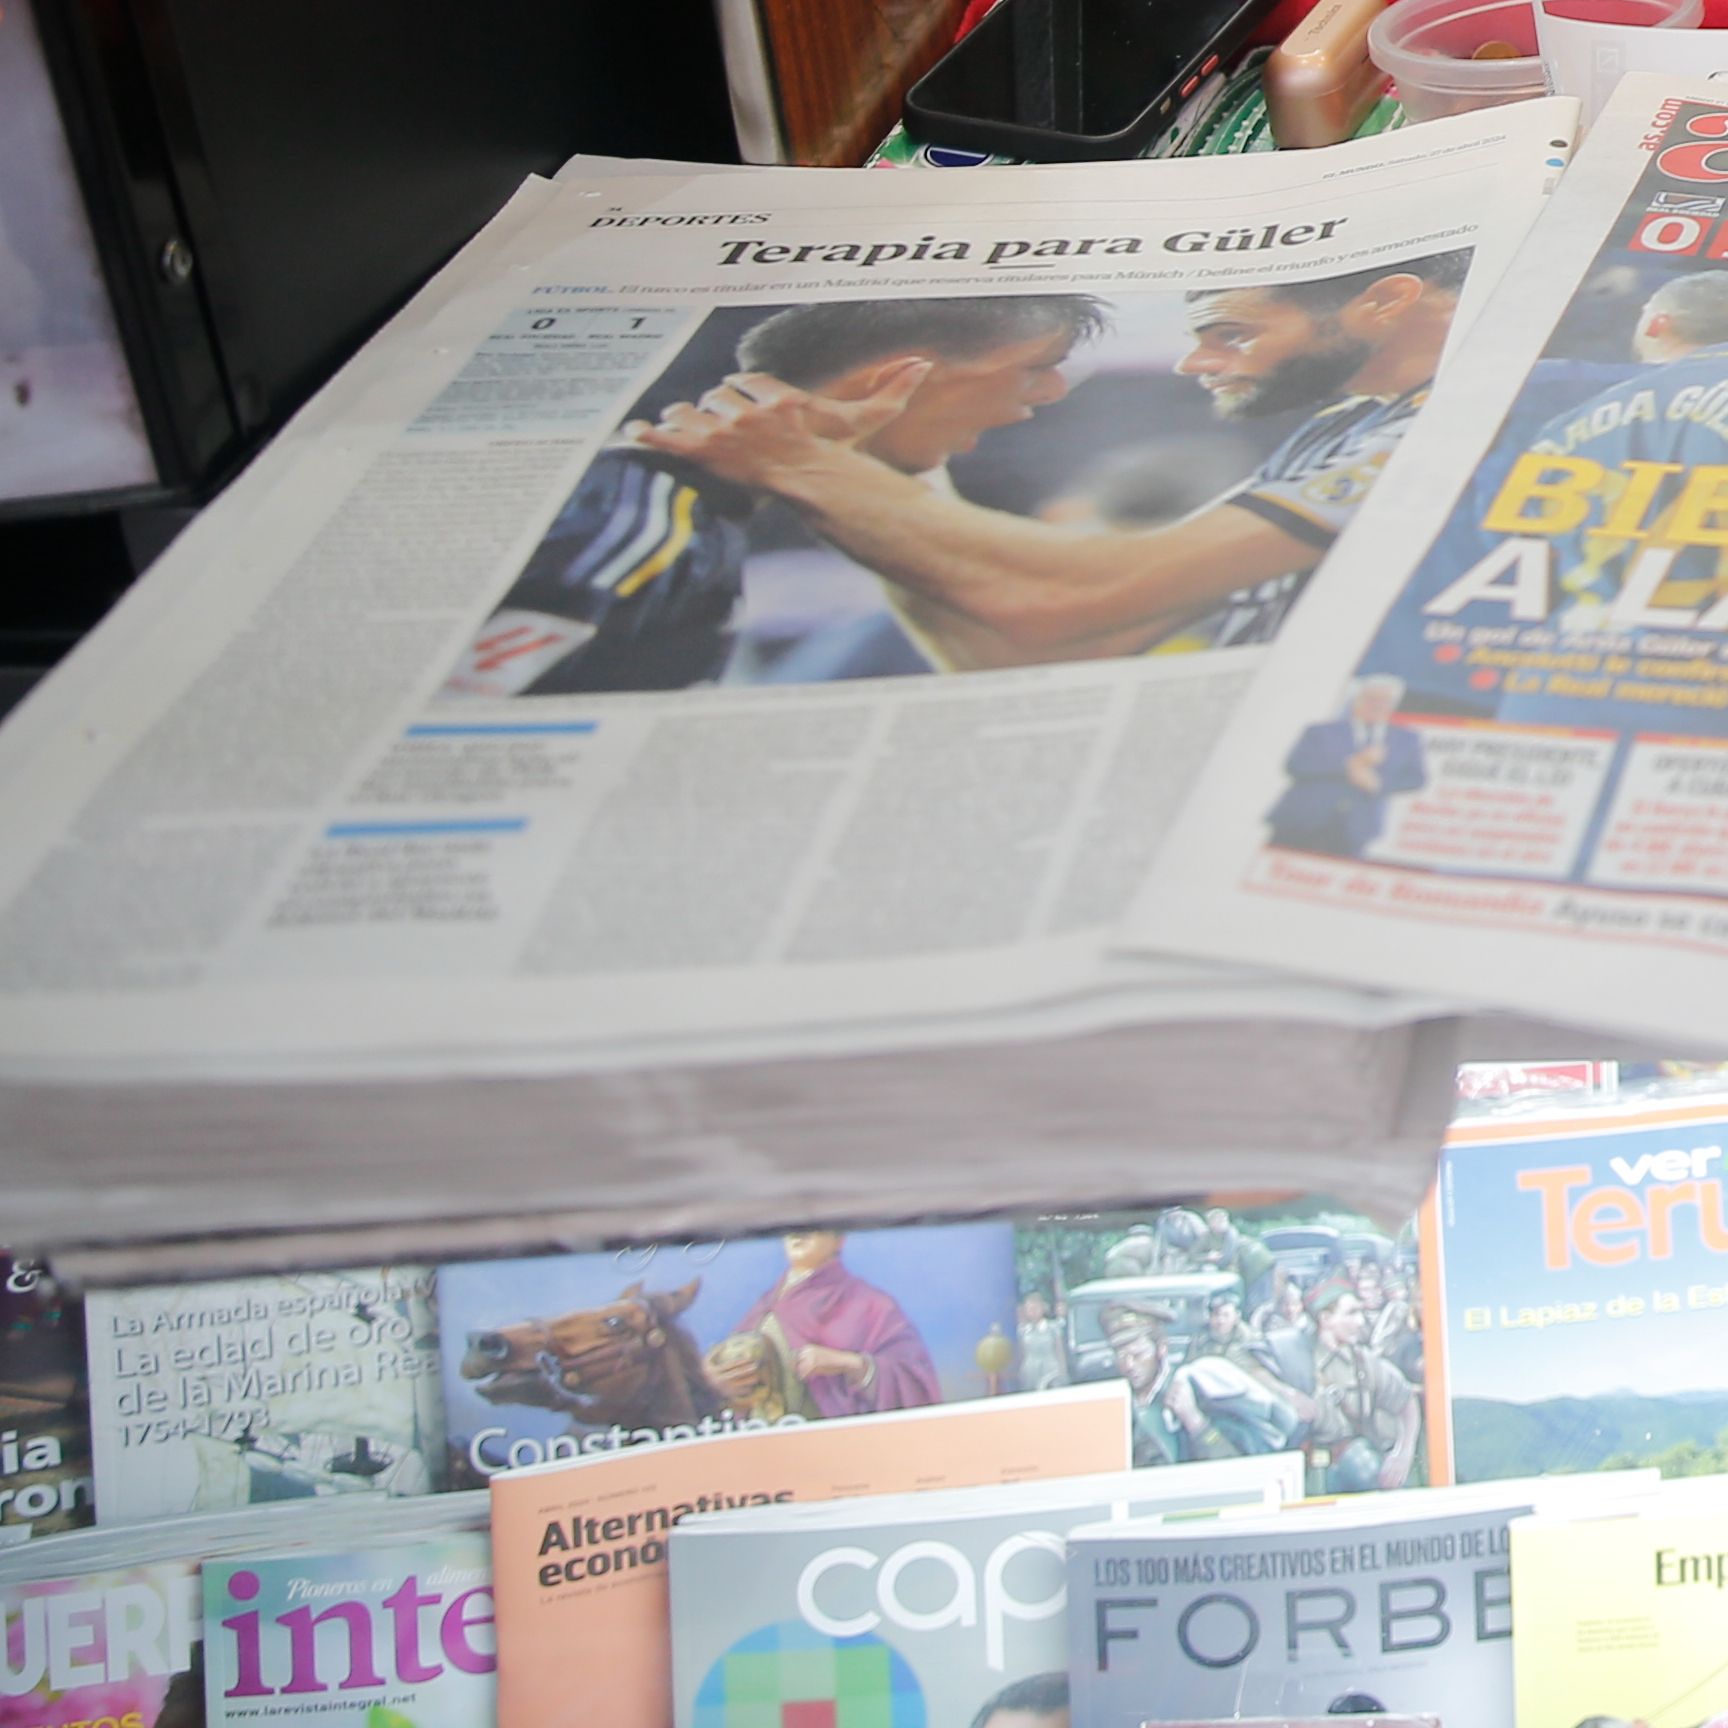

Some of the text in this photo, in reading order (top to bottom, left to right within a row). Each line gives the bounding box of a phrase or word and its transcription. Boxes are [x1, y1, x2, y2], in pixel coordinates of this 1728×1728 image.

[1638, 99, 1682, 151] as.com
[588, 212, 773, 228] DEPORTES
[717, 216, 1350, 268] Terapia para Güler
[1639, 217, 1695, 251] 0
[1422, 535, 1551, 622] A
[153, 1281, 402, 1333] Armada española
[1499, 1296, 1598, 1331] Lapiaz
[113, 1325, 337, 1379] La edad de
[115, 1358, 364, 1417] de Marina
[537, 1489, 795, 1557] Alternativas
[1220, 1535, 1456, 1583] CREATIVOS MUNDO
[797, 1530, 1070, 1672] cap
[222, 1569, 499, 1698] inte
